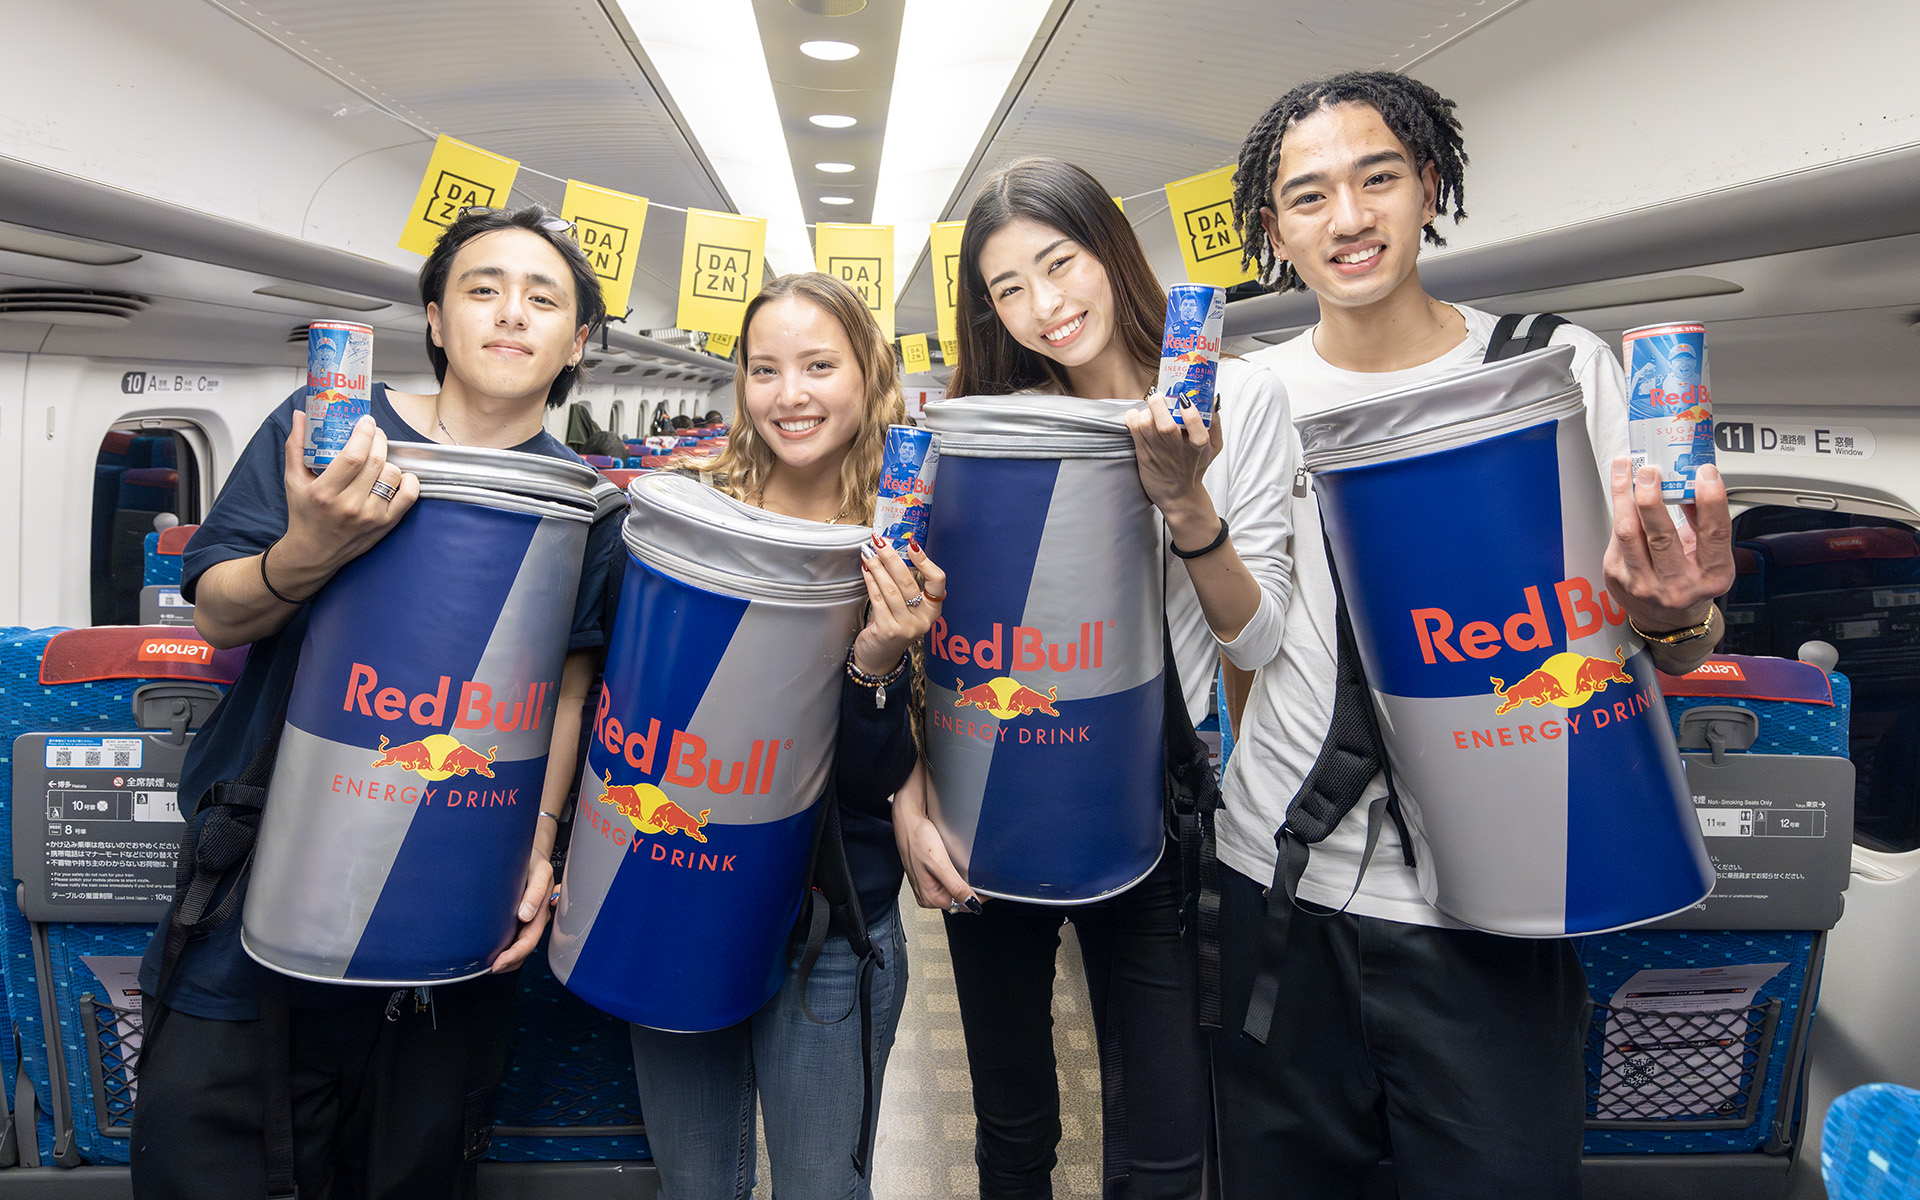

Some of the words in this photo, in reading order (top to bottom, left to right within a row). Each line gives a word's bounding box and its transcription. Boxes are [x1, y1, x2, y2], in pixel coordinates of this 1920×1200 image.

[1166, 333, 1195, 350] Red
[1196, 335, 1220, 353] Bull
[307, 371, 332, 389] Red
[334, 372, 366, 390] Bull
[1164, 365, 1193, 373] ENERGY
[126, 374, 142, 392] 10
[147, 375, 157, 391] A
[174, 375, 183, 391] B
[197, 376, 207, 392] C
[1650, 384, 1696, 407] Red
[1722, 426, 1745, 449] 11
[1760, 428, 1778, 450] D
[1815, 429, 1831, 454] E
[1835, 448, 1863, 456] Window
[884, 474, 913, 492] Red
[1410, 585, 1554, 664] Red
[1554, 576, 1626, 641] Bu
[146, 643, 208, 660] Lenovo
[931, 615, 1003, 670] Red
[1012, 620, 1104, 672] Bull
[343, 662, 451, 727] Red
[454, 681, 547, 732] Bull
[934, 710, 1009, 743] ENERGY
[1019, 725, 1090, 745] DRINK
[1452, 714, 1582, 749] ENERGY
[1592, 683, 1658, 730] DRINK
[595, 680, 661, 775] Red
[664, 729, 780, 795] Bull
[126, 777, 165, 787] 全席禁煙
[331, 773, 438, 806] ENERGY
[447, 788, 519, 808] DRINK
[1760, 799, 1773, 807] Only
[580, 792, 644, 853] ENERGY
[651, 843, 737, 872] DRINK
